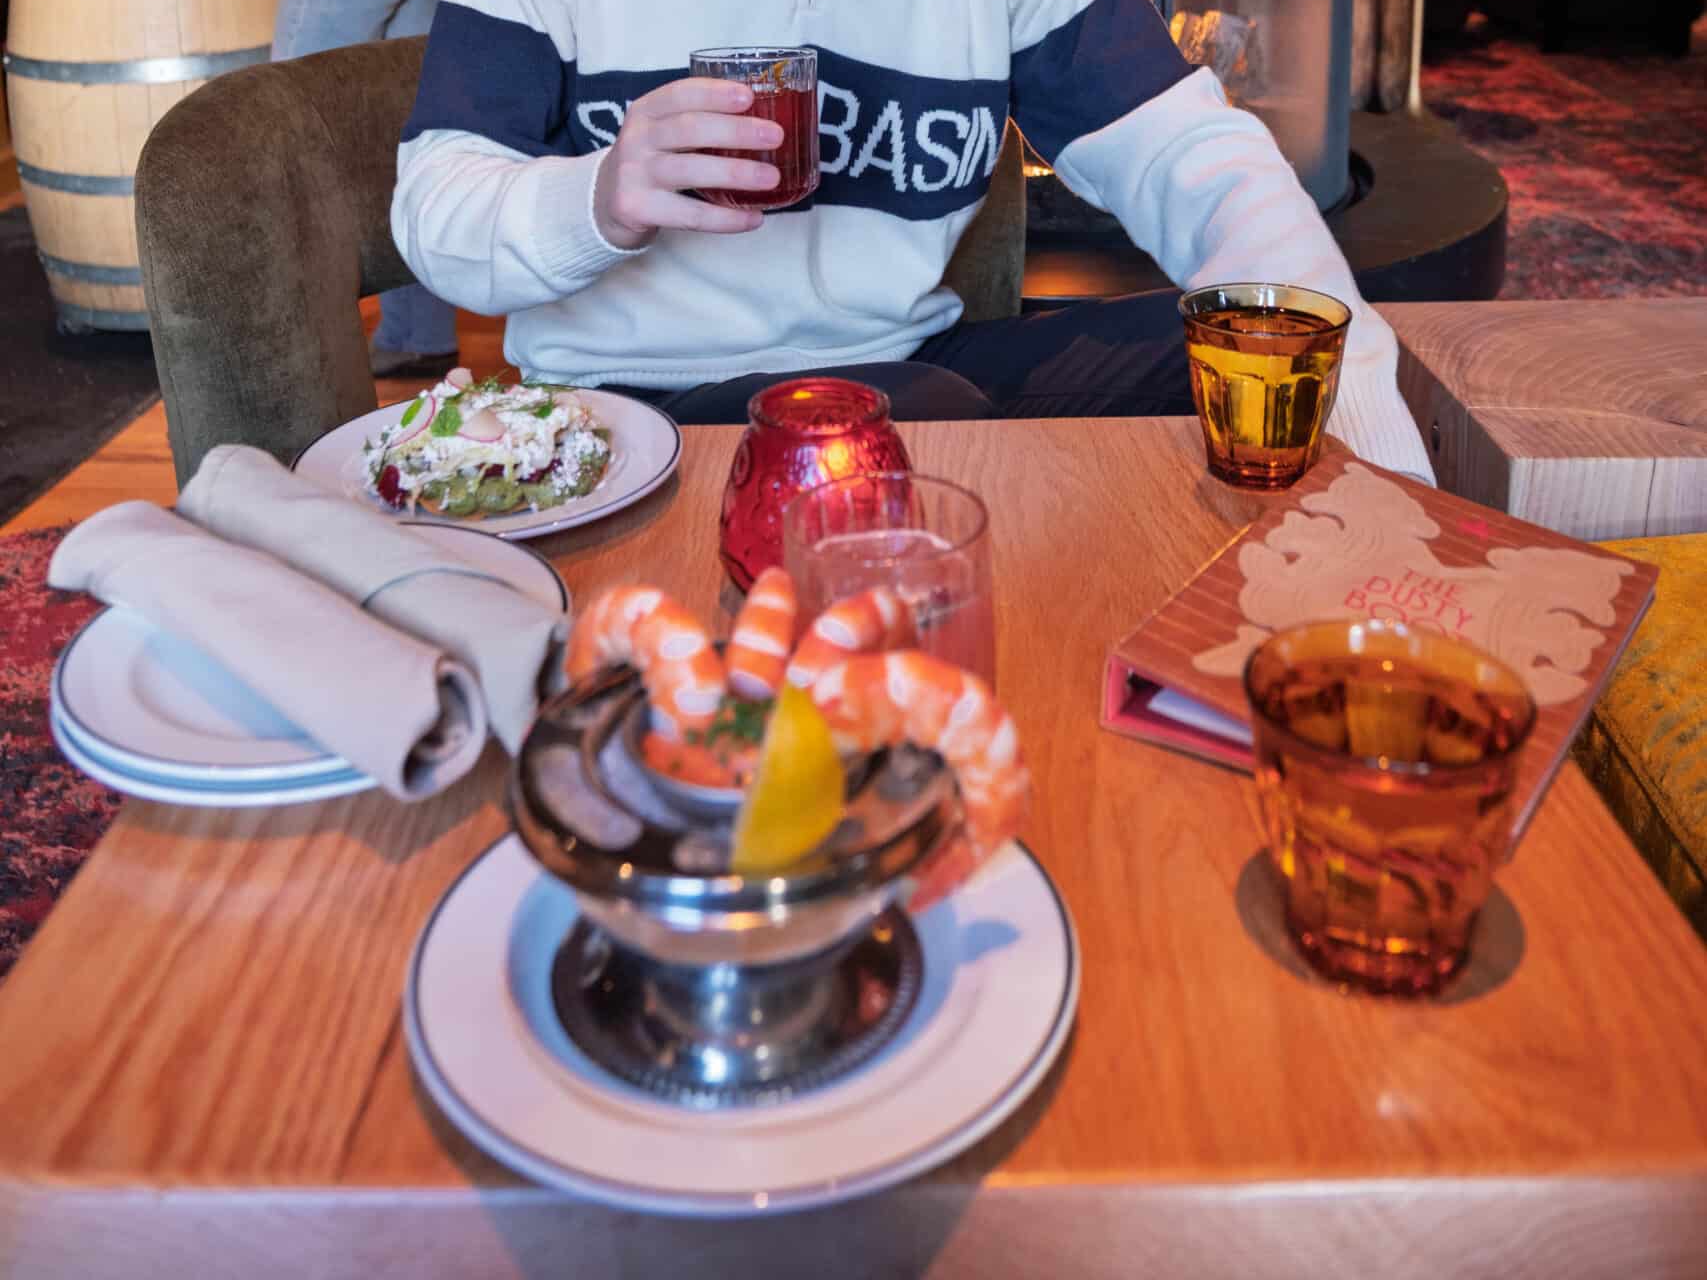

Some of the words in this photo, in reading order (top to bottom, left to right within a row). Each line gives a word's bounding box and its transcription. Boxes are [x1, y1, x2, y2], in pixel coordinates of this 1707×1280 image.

[816, 80, 998, 193] BASIN
[1364, 575, 1473, 629] DUSTY
[1404, 569, 1464, 605] THE
